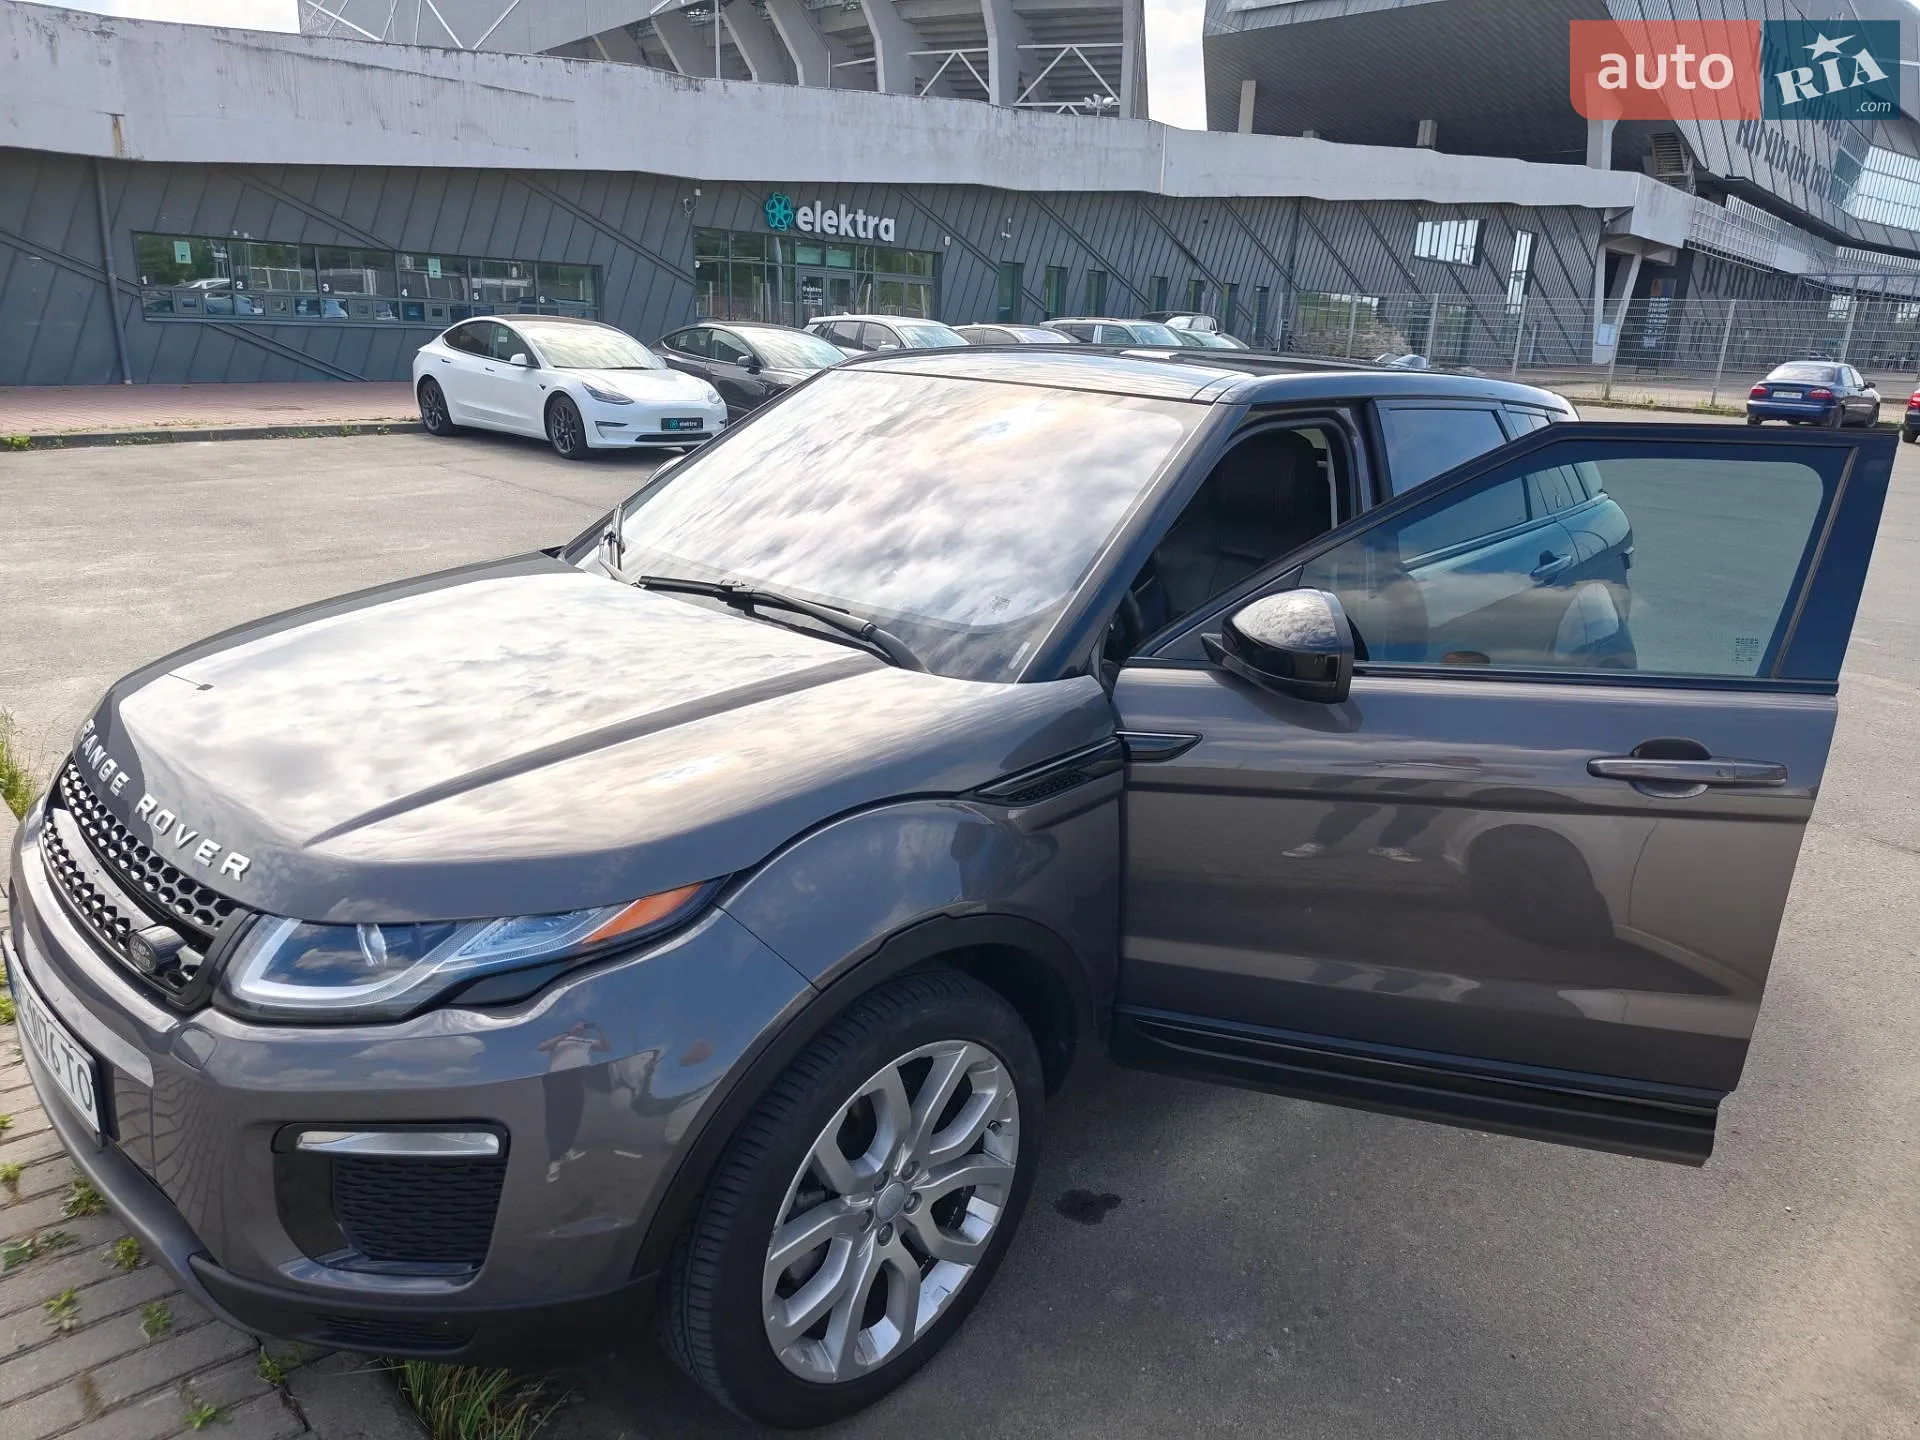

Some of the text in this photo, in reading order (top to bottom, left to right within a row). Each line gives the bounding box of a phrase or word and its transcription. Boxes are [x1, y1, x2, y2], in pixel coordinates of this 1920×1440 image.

[796, 200, 896, 242] elektra
[236, 281, 244, 290] 2
[322, 283, 330, 292] 3
[401, 288, 408, 297] 4
[473, 292, 479, 300] 5
[539, 295, 546, 304] 6
[80, 718, 251, 882] RANGE ROVER
